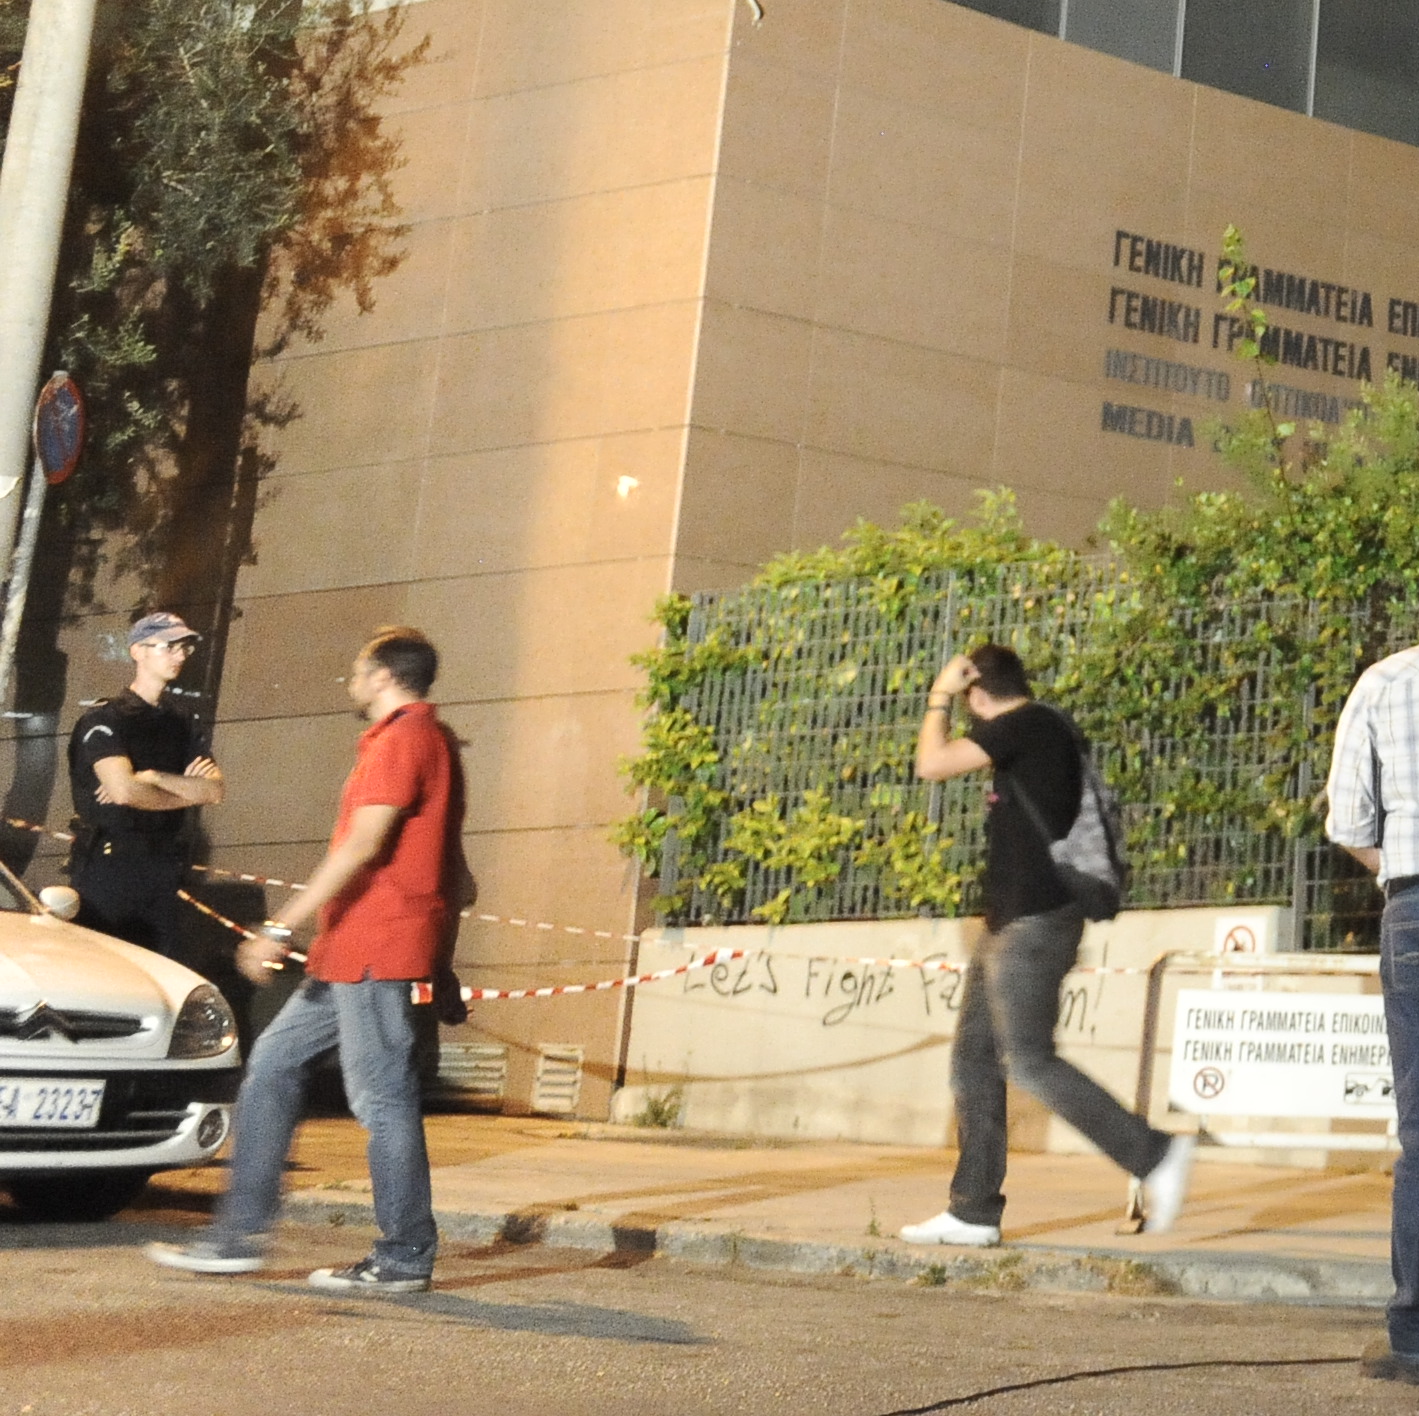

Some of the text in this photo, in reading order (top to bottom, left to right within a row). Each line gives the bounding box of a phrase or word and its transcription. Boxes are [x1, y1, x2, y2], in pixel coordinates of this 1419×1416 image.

[1113, 229, 1204, 288] ΓΕΝΙΚΗ
[1108, 286, 1201, 344] ΓΕΝΙΚΗ
[1102, 401, 1195, 448] MEDIA
[1186, 1008, 1386, 1035] ΓΕΝΙΚΗ ΓΡΑΜΜΑΤΕΙΑ ΕΠΙΚΟΙΝ
[1183, 1040, 1391, 1066] ΓΕΝΙΚΗ ΓΡΑΜΜΑΤΕΙΑ ΕΝΗΜΕΡ
